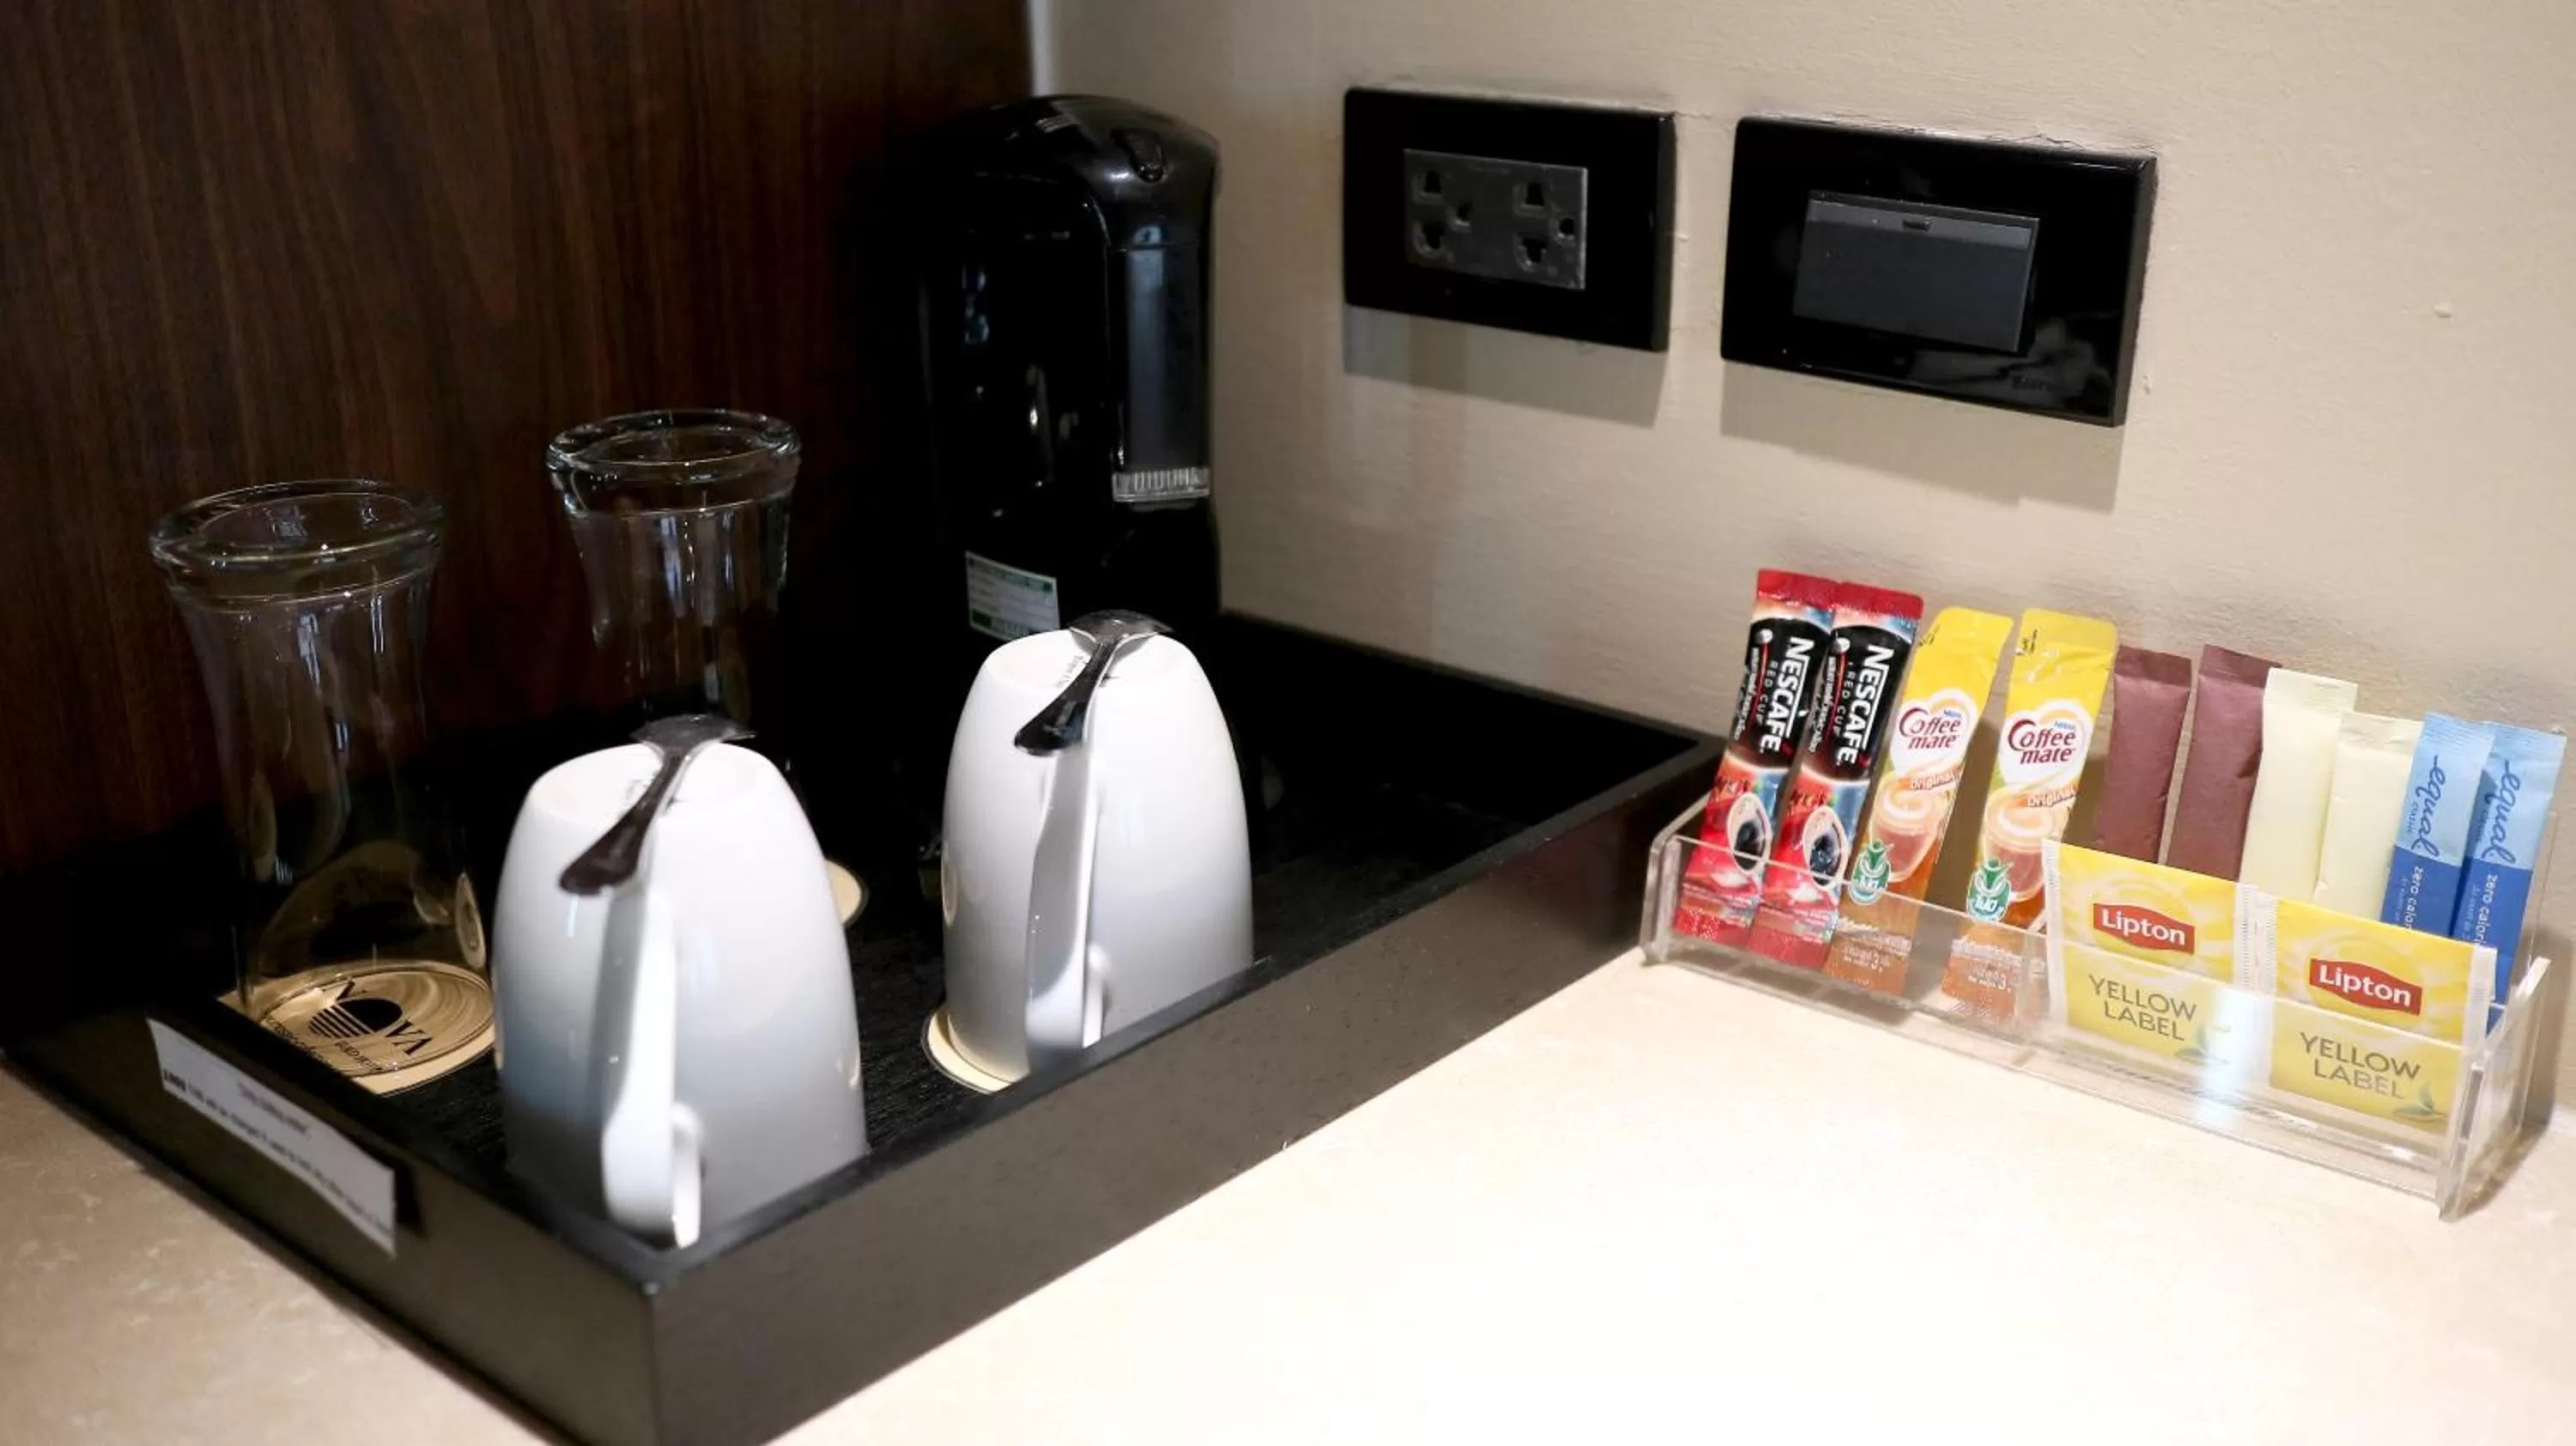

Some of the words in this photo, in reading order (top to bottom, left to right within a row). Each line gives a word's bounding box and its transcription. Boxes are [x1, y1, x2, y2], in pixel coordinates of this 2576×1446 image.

[1843, 671, 1856, 699] RED
[1899, 707, 1961, 738] Coffee
[2008, 719, 2075, 751] Coffee
[1908, 733, 1958, 750] mate
[2020, 748, 2072, 765] mate
[2411, 755, 2446, 857] equal
[2482, 759, 2520, 864] equal
[2409, 866, 2424, 894] zero
[2482, 873, 2498, 902] zero
[2101, 908, 2185, 945] Lipton
[2404, 896, 2418, 931] calor
[2474, 906, 2490, 946] calori
[2089, 974, 2197, 1022] YELLOW
[2318, 964, 2411, 1007] Lipton
[2104, 999, 2185, 1042] LABEL
[2300, 1030, 2421, 1080] YELLOW
[2314, 1058, 2405, 1100] LABEL
